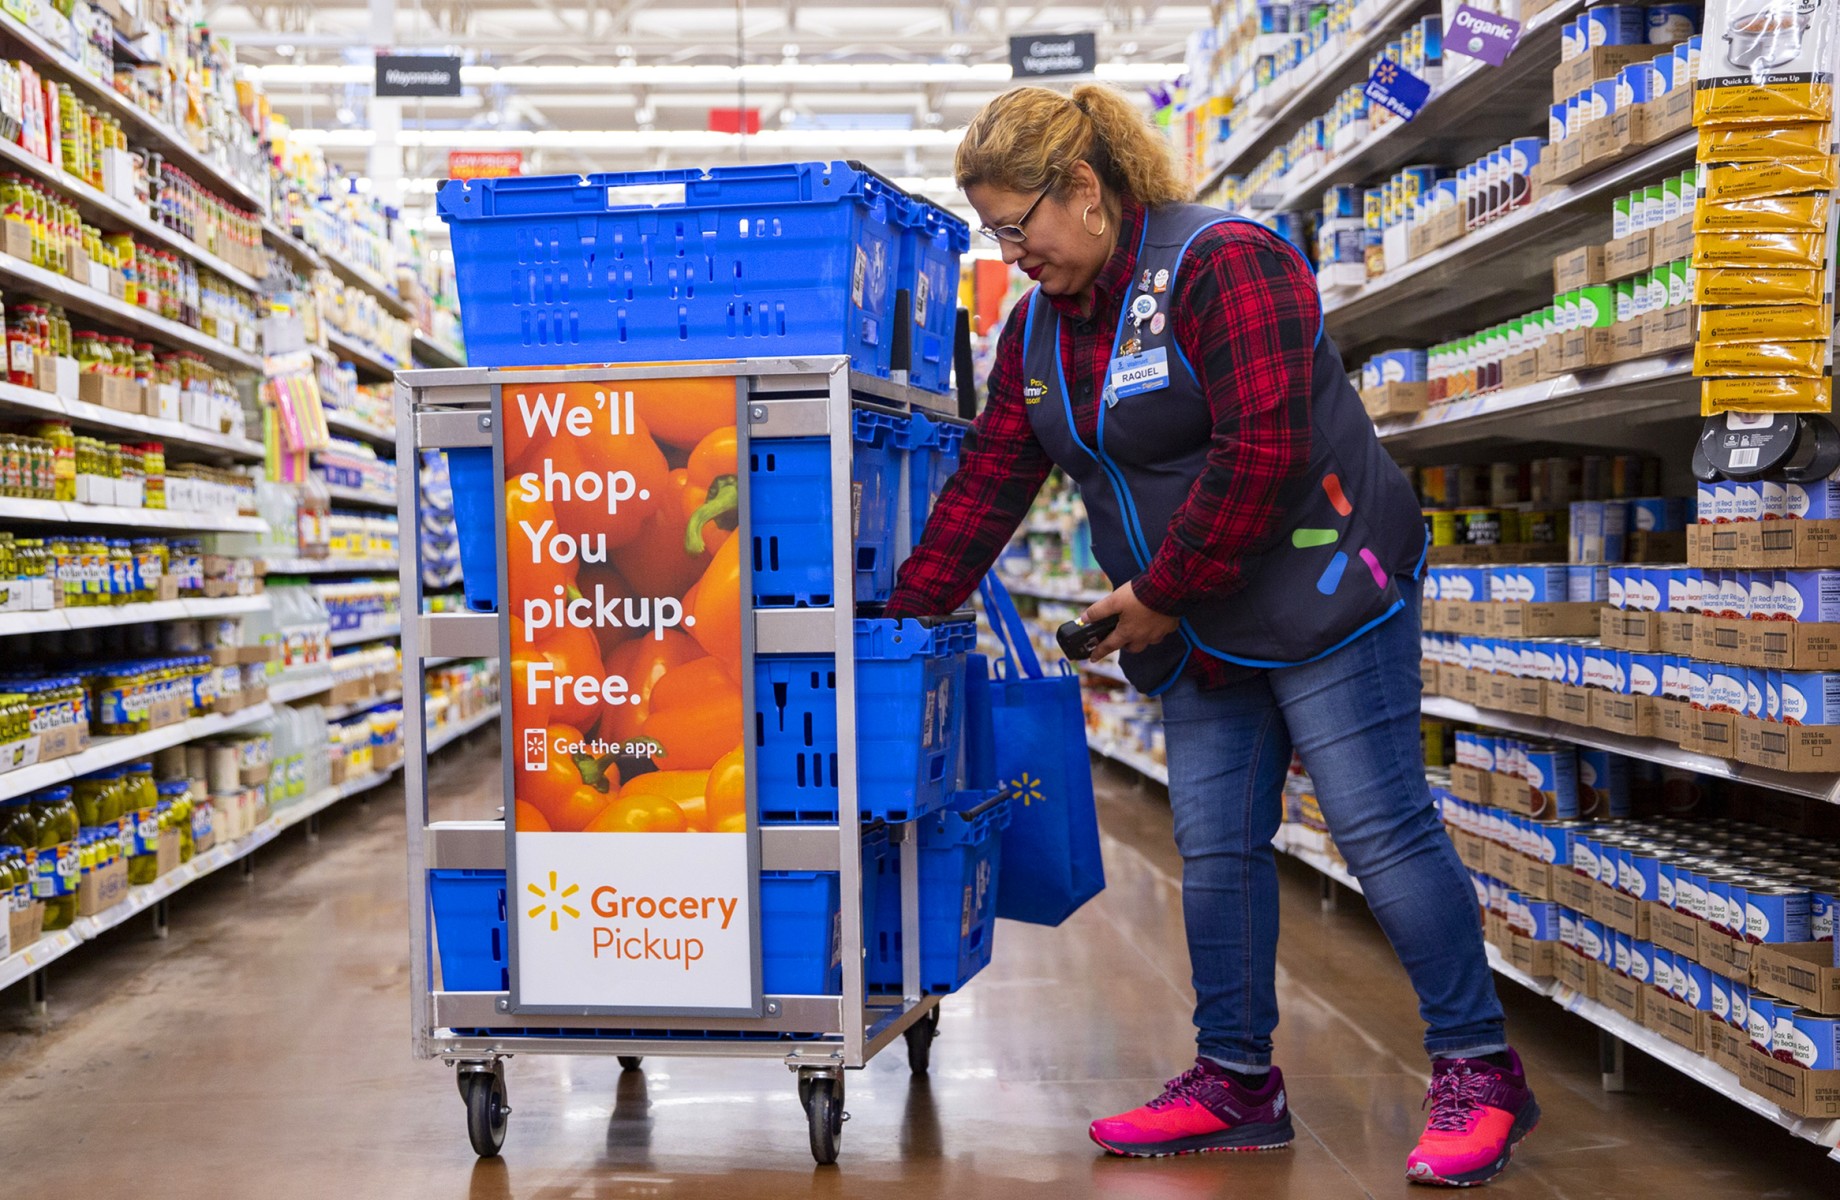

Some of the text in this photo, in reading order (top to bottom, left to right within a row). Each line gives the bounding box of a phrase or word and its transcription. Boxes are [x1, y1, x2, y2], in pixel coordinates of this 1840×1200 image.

[1456, 11, 1513, 40] Organic
[386, 69, 450, 87] Mayonnaise
[1722, 78, 1742, 86] Quick
[1789, 75, 1800, 83] Up
[1366, 85, 1388, 105] Low
[1387, 96, 1414, 120] Price
[1709, 144, 1715, 153] 6
[1718, 185, 1723, 194] 6
[1705, 215, 1711, 224] 6
[1703, 251, 1709, 259] 6
[1704, 287, 1710, 295] 6
[1711, 328, 1717, 336] 6
[1705, 359, 1710, 367] 6
[1122, 367, 1159, 382] RAQUEL
[1712, 398, 1717, 406] 6
[516, 391, 635, 438] We’ll
[519, 458, 651, 515] shop.
[518, 520, 607, 564] You
[524, 583, 696, 642] pickup.
[527, 661, 641, 705] Free.
[553, 737, 663, 758] Get the app.
[590, 885, 739, 930] Grocery
[593, 927, 704, 970] Pickup
